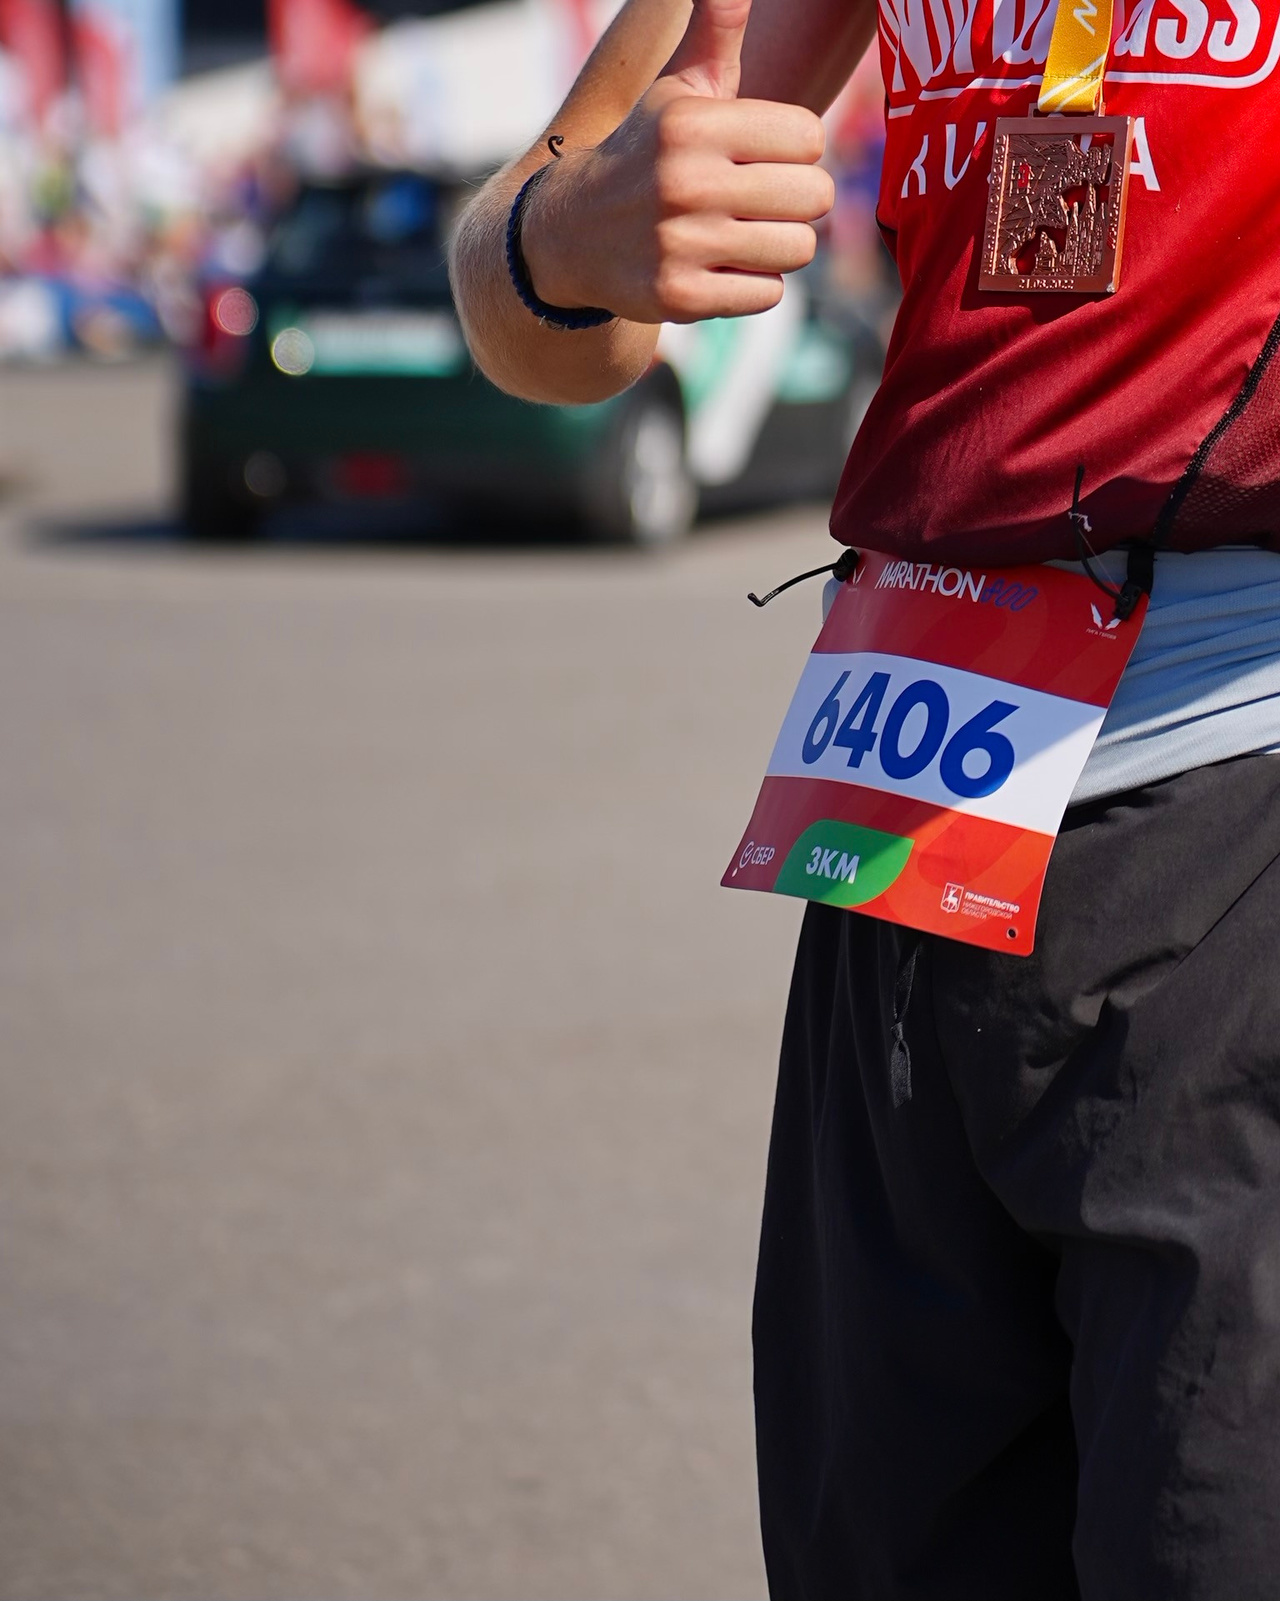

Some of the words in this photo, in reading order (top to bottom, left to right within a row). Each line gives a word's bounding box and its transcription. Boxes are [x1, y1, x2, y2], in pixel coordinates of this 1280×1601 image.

[874, 561, 986, 603] MARATHON
[801, 670, 1021, 799] 6406
[751, 846, 776, 865] СБЕР
[964, 891, 1020, 914] ПРАВИТЕЛЬСТВО
